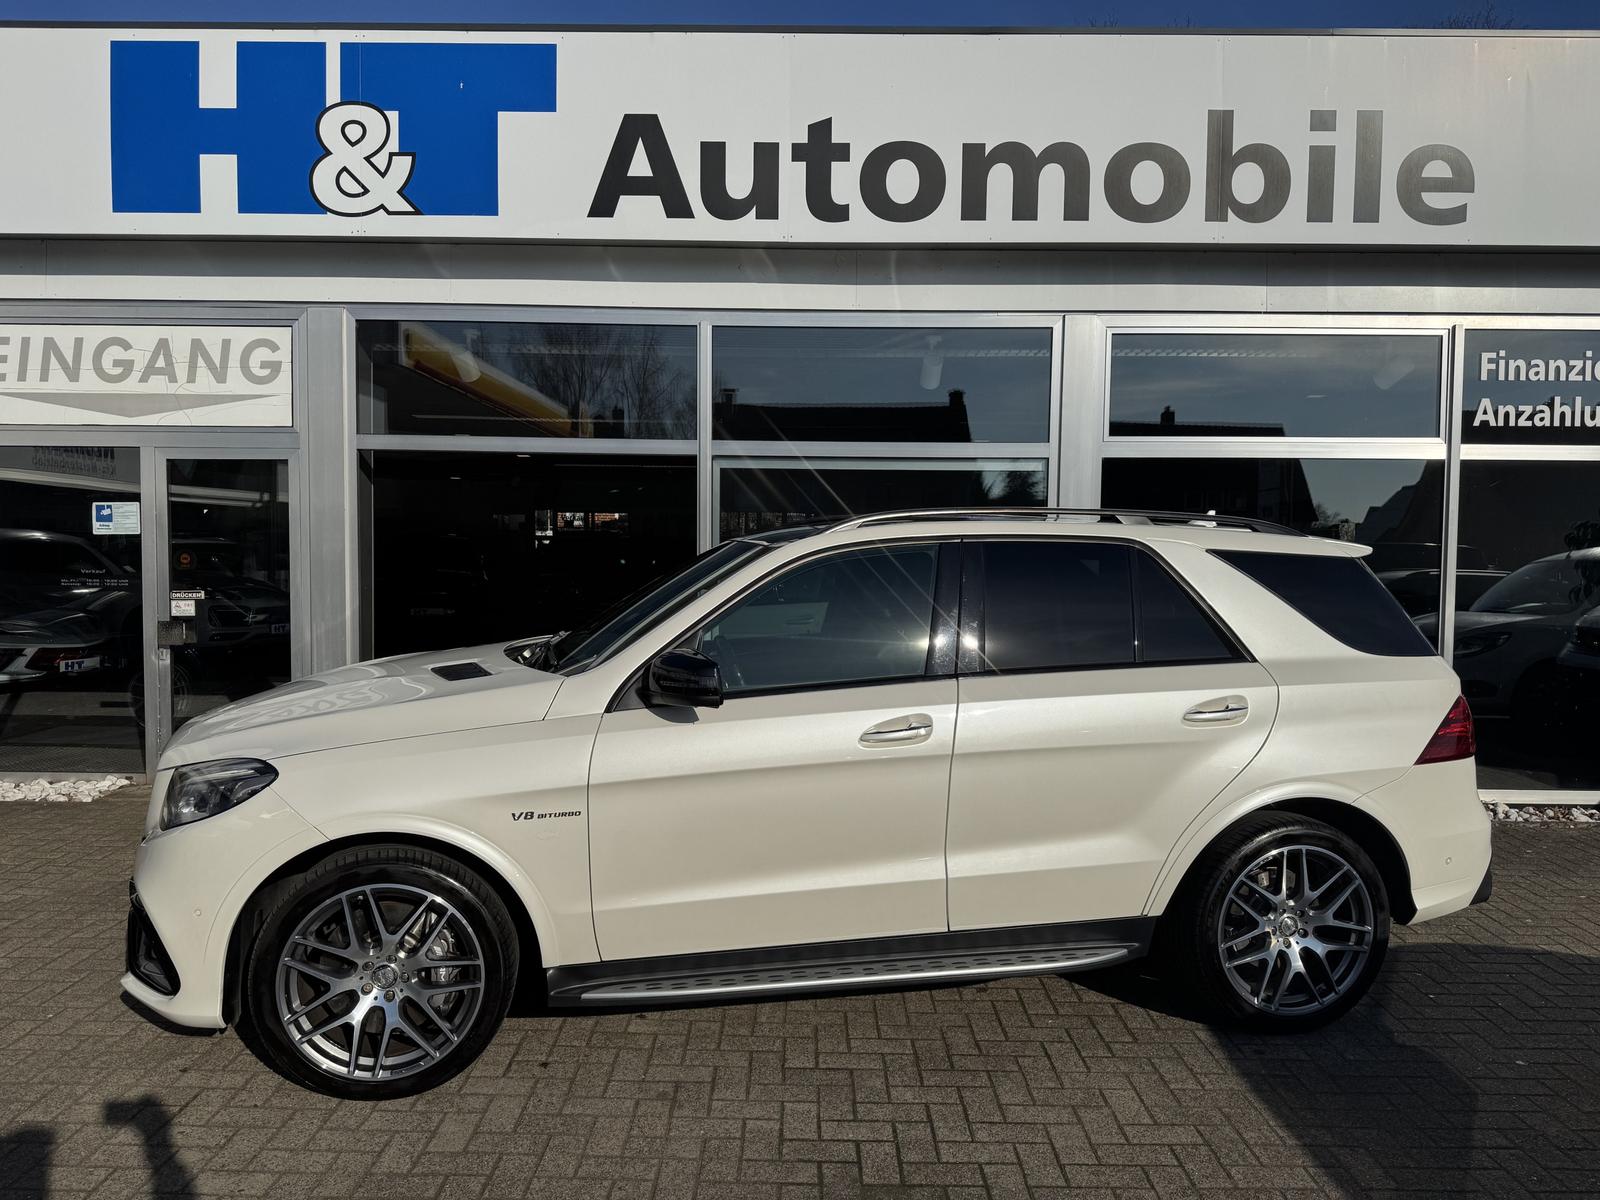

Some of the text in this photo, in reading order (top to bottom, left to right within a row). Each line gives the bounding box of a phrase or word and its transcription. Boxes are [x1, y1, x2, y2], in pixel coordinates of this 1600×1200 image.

[110, 41, 1476, 226] H&T Automobile
[1472, 396, 1600, 427] Anzahlu
[64, 660, 85, 671] HT
[511, 811, 582, 821] V8 BITURBO
